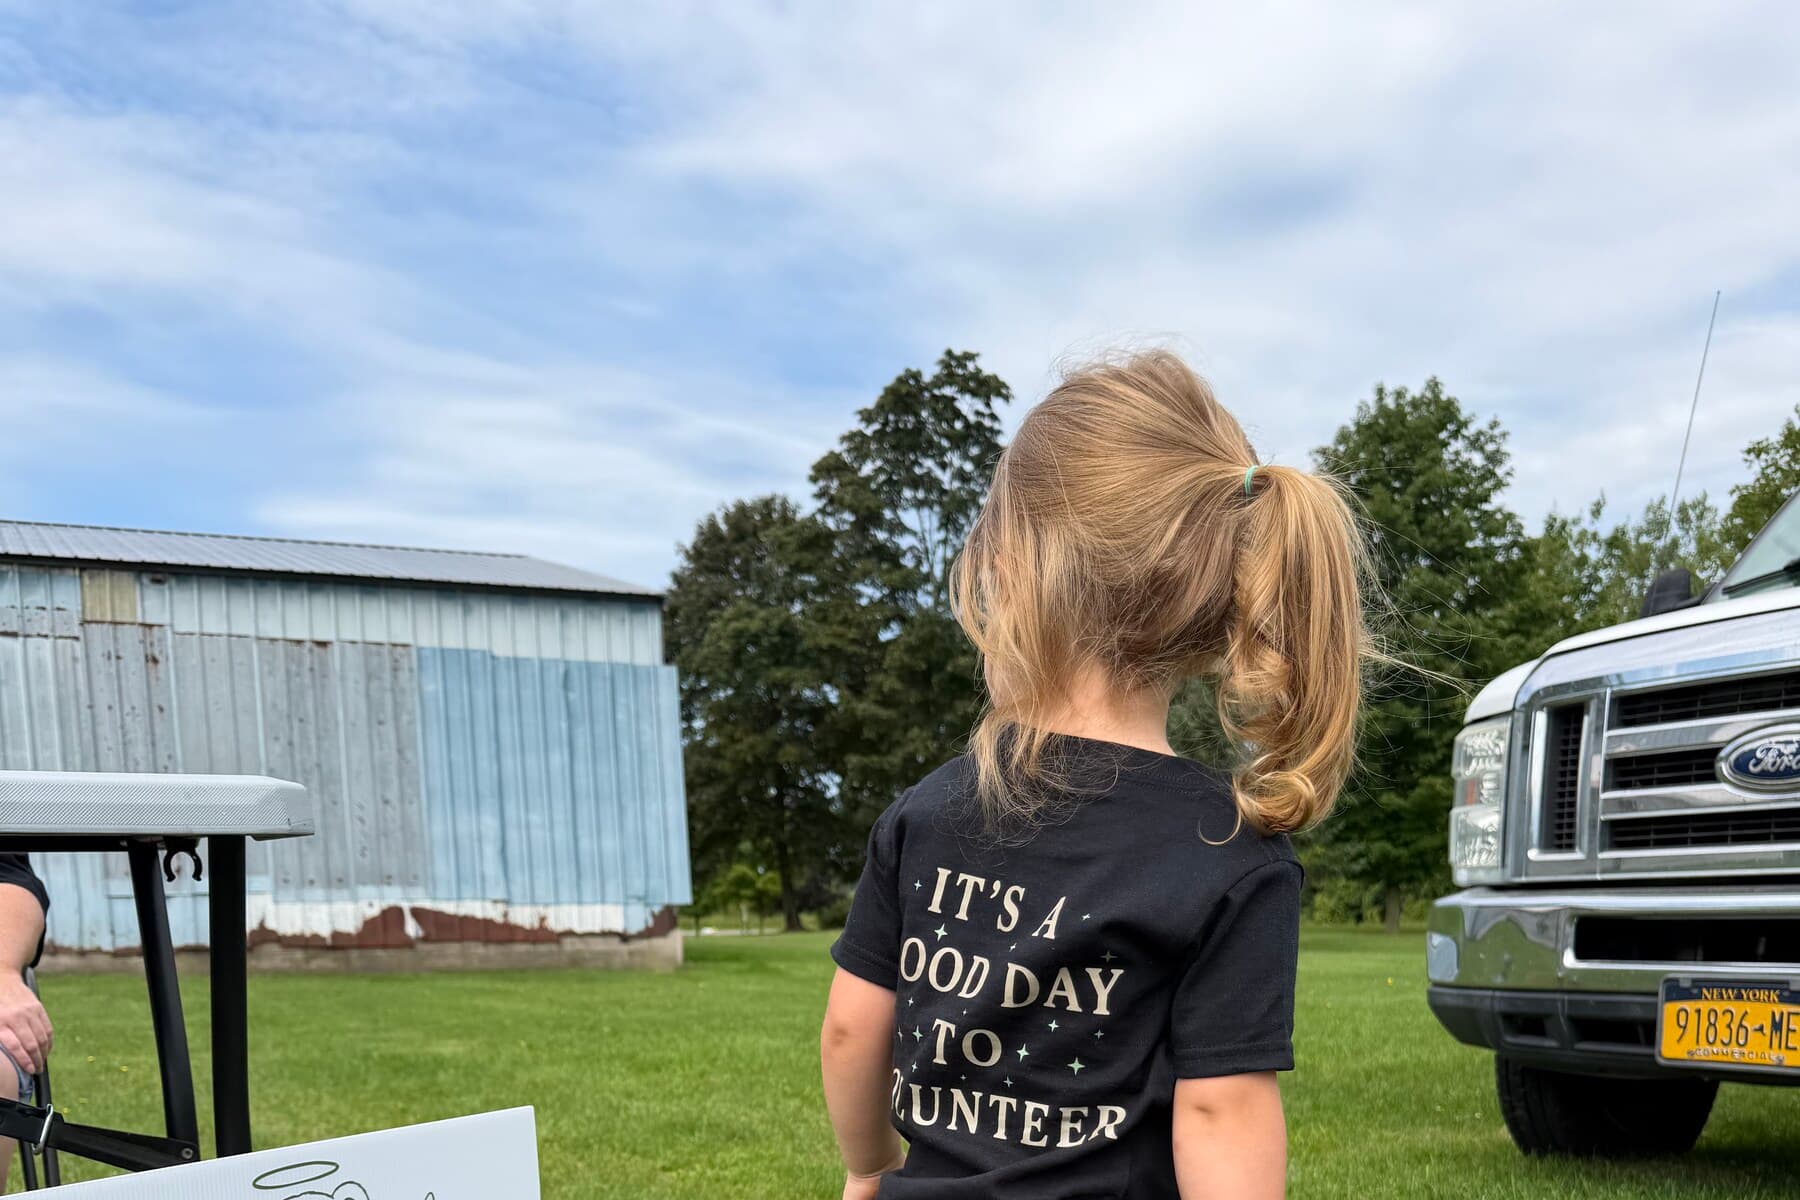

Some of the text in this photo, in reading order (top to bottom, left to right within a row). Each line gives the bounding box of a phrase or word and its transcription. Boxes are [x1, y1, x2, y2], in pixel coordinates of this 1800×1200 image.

[927, 867, 1066, 939] IT'S A
[900, 937, 1124, 1015] OOD DAY
[1702, 987, 1780, 1003] NEW YORK
[932, 1018, 1002, 1067] TO
[891, 1068, 1127, 1148] LUNTEER
